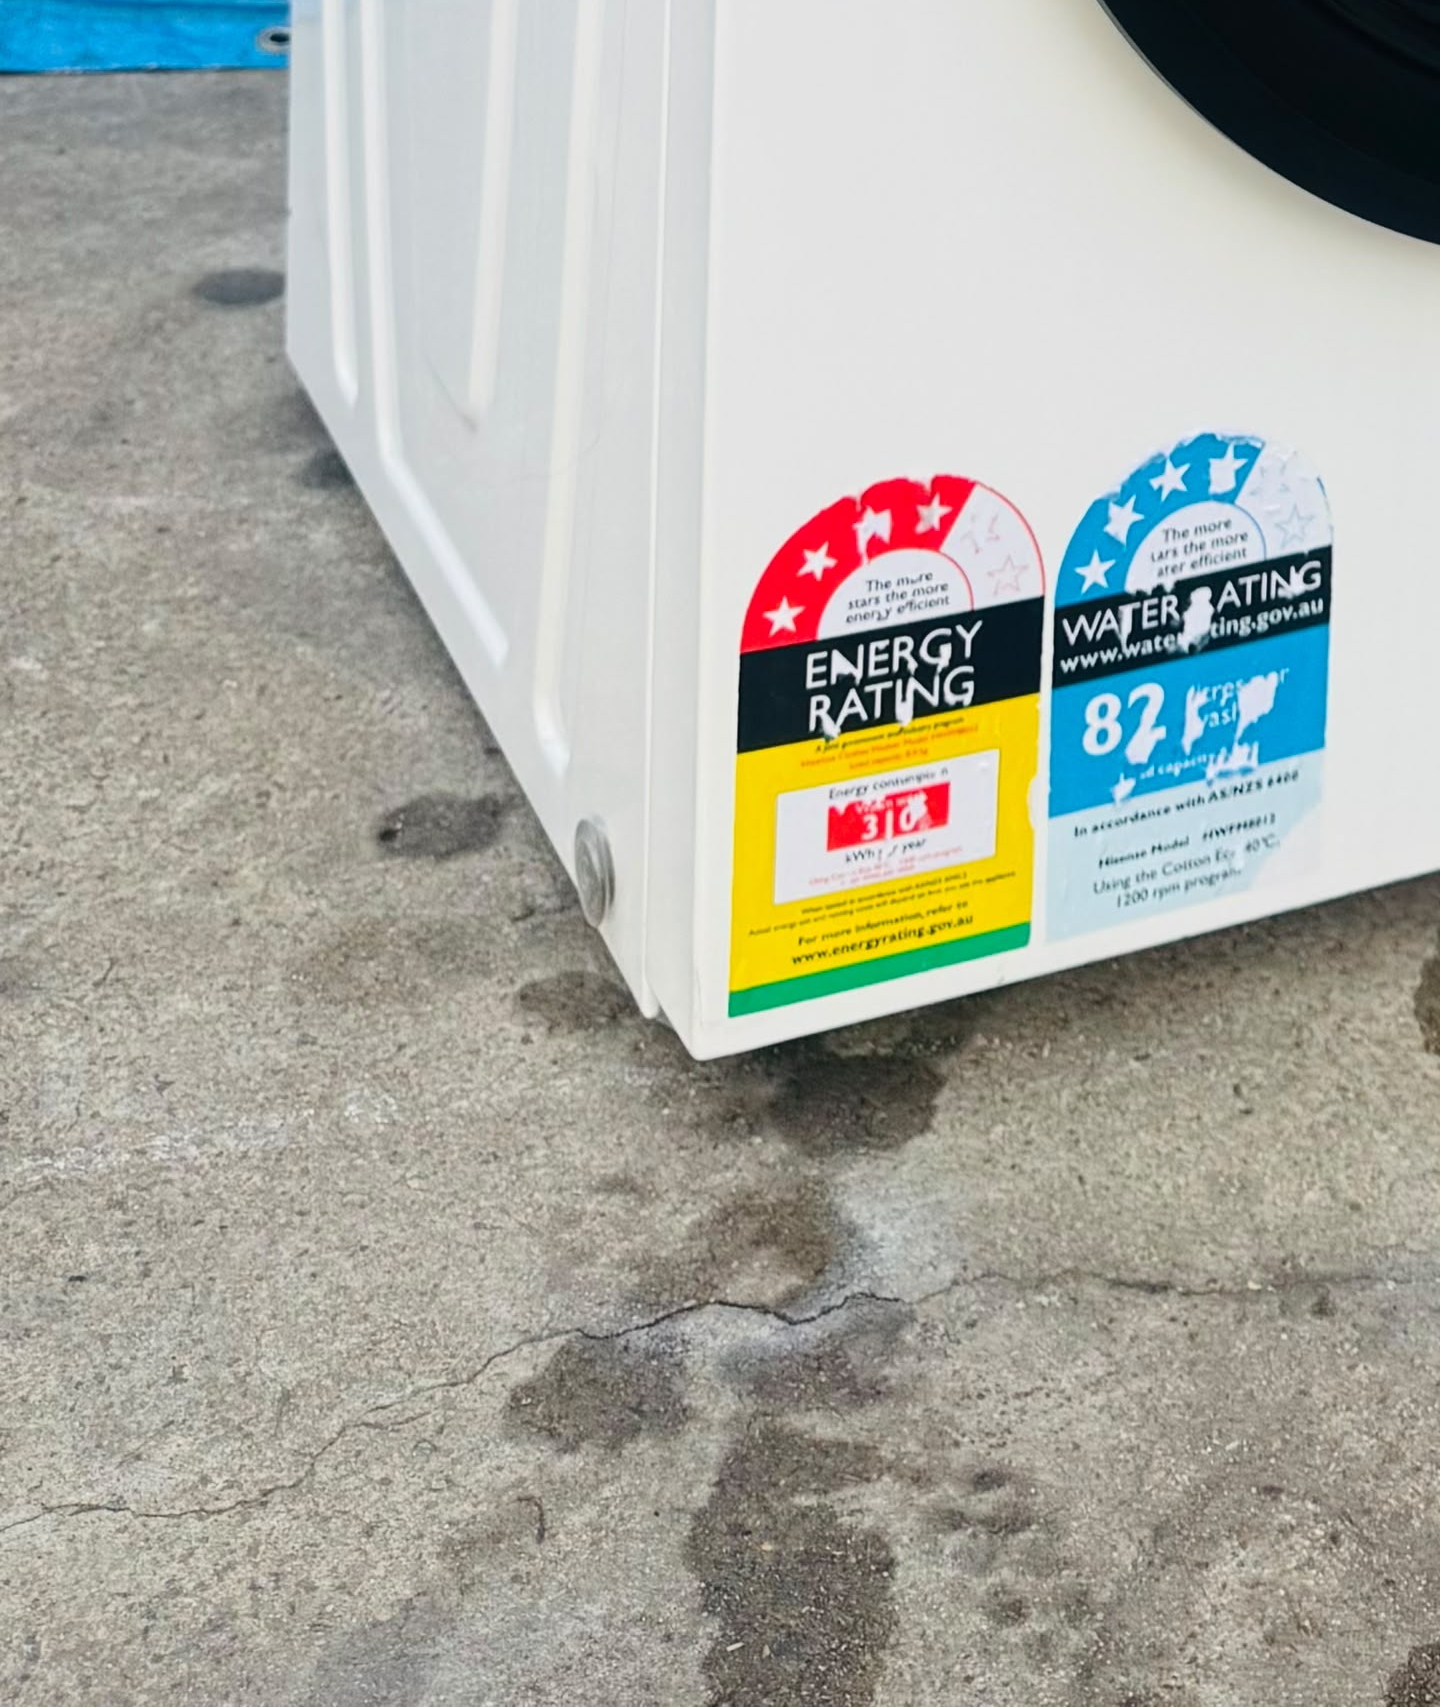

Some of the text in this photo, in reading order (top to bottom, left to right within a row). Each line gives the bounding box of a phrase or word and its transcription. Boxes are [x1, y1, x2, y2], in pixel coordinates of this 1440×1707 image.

[1162, 519, 1232, 543] The more
[1150, 532, 1248, 563] tars the more
[1157, 547, 1246, 578] ater efficient
[848, 582, 949, 610] stars the more
[866, 578, 892, 593] The
[1063, 559, 1322, 647] WATER ATING
[806, 620, 983, 690] ENERGY
[808, 666, 975, 737] RATING
[1082, 682, 1166, 765] 82
[829, 784, 868, 800] Energy
[1074, 825, 1088, 838] In
[1091, 806, 1171, 833] accordance
[1175, 793, 1205, 813] with
[1151, 836, 1190, 855] Model
[1092, 875, 1132, 895] Using
[1135, 867, 1158, 883] the
[1161, 854, 1212, 877] Cotton
[1116, 889, 1149, 908] 1200
[1152, 881, 1182, 902] rpm
[791, 914, 974, 966] www.energyrating.gov.au
